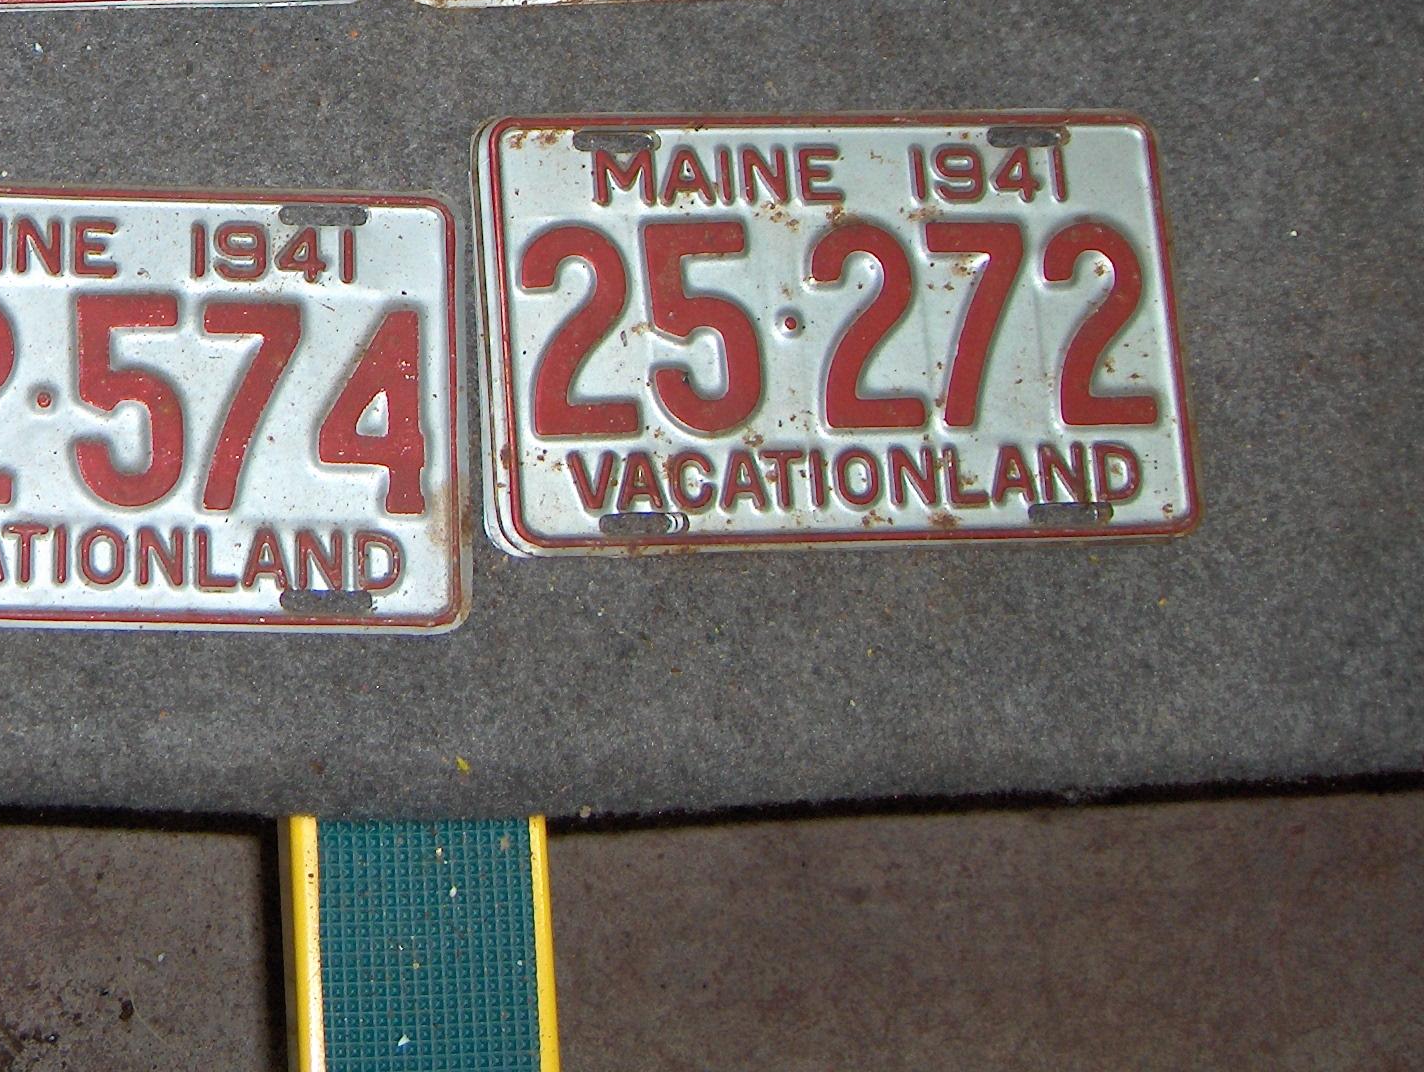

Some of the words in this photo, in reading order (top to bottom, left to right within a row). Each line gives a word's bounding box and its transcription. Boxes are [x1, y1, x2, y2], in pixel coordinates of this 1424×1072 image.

[595, 144, 844, 205] MAINE
[910, 143, 1067, 203] 1941
[191, 222, 354, 283] 1941
[567, 442, 1140, 510] VACATIONLAND
